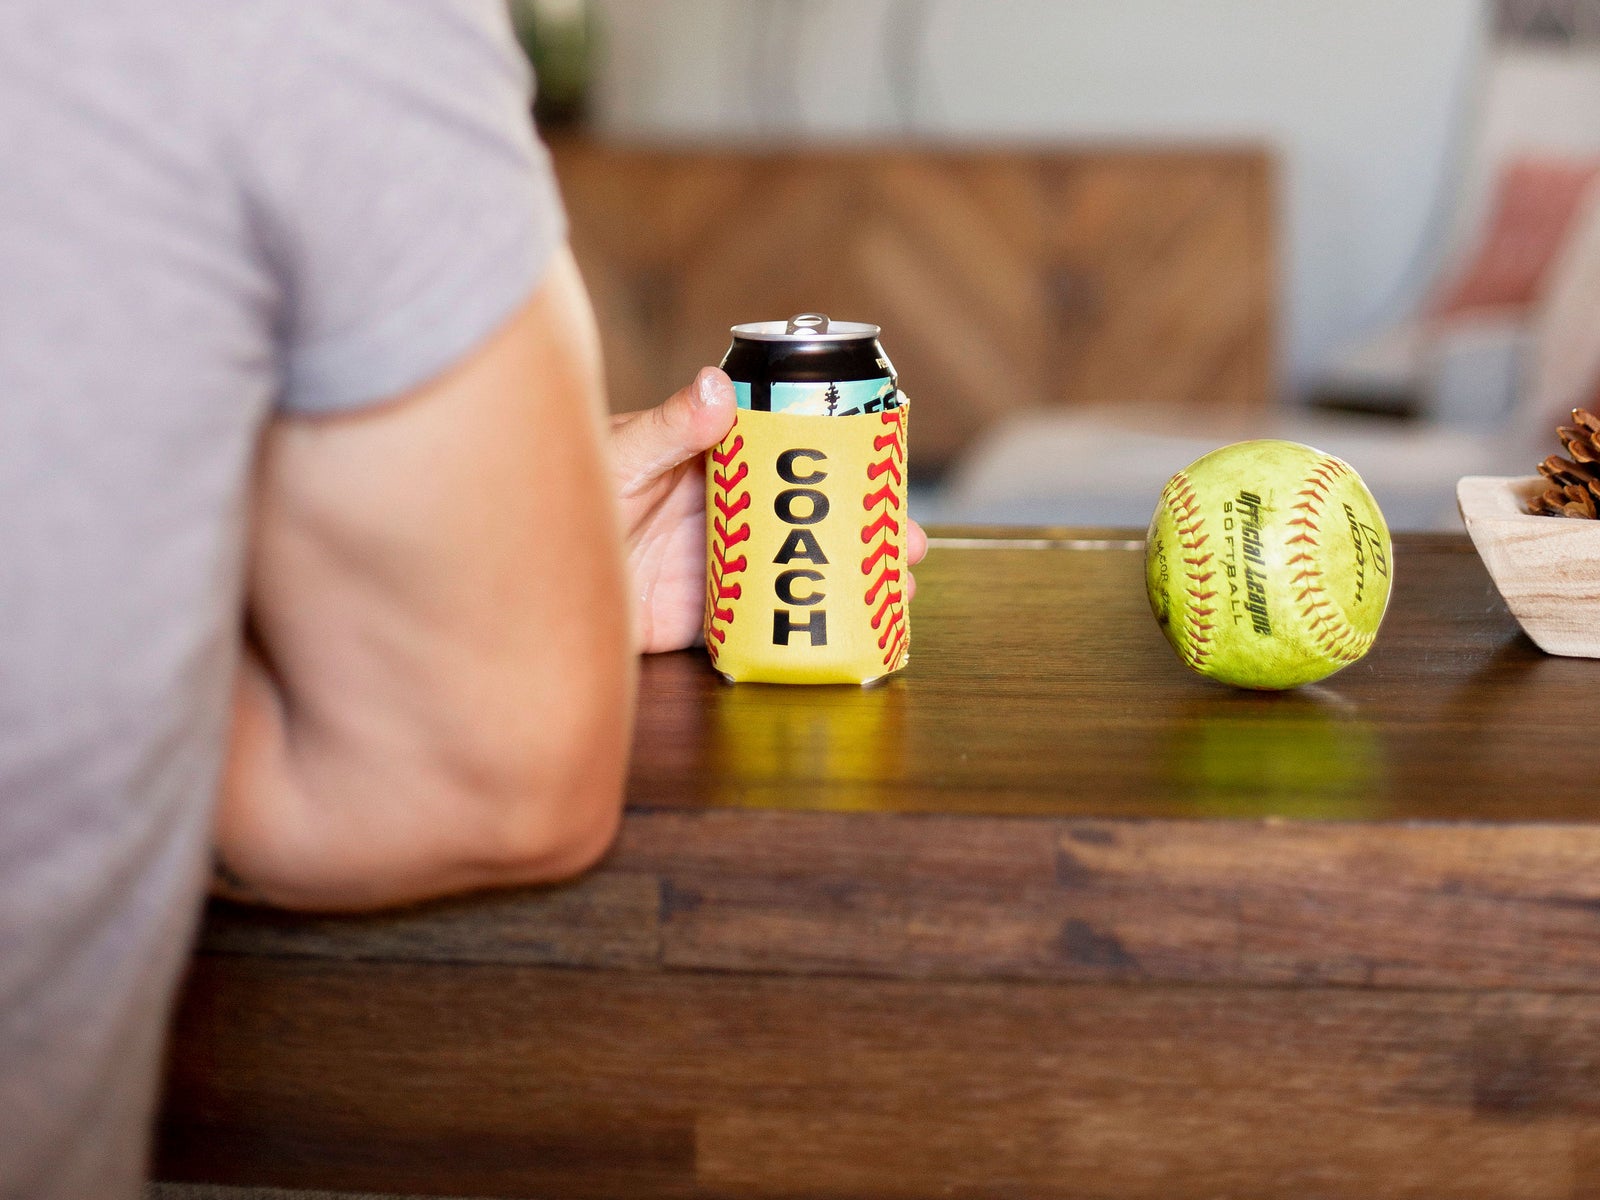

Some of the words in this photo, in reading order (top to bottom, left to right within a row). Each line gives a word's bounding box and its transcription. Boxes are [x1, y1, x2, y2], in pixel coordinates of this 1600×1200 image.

[772, 447, 830, 647] COACH
[1223, 501, 1243, 626] SOFTBALL
[1235, 490, 1266, 567] Official
[1342, 502, 1365, 603] WORTH
[1243, 564, 1273, 636] League
